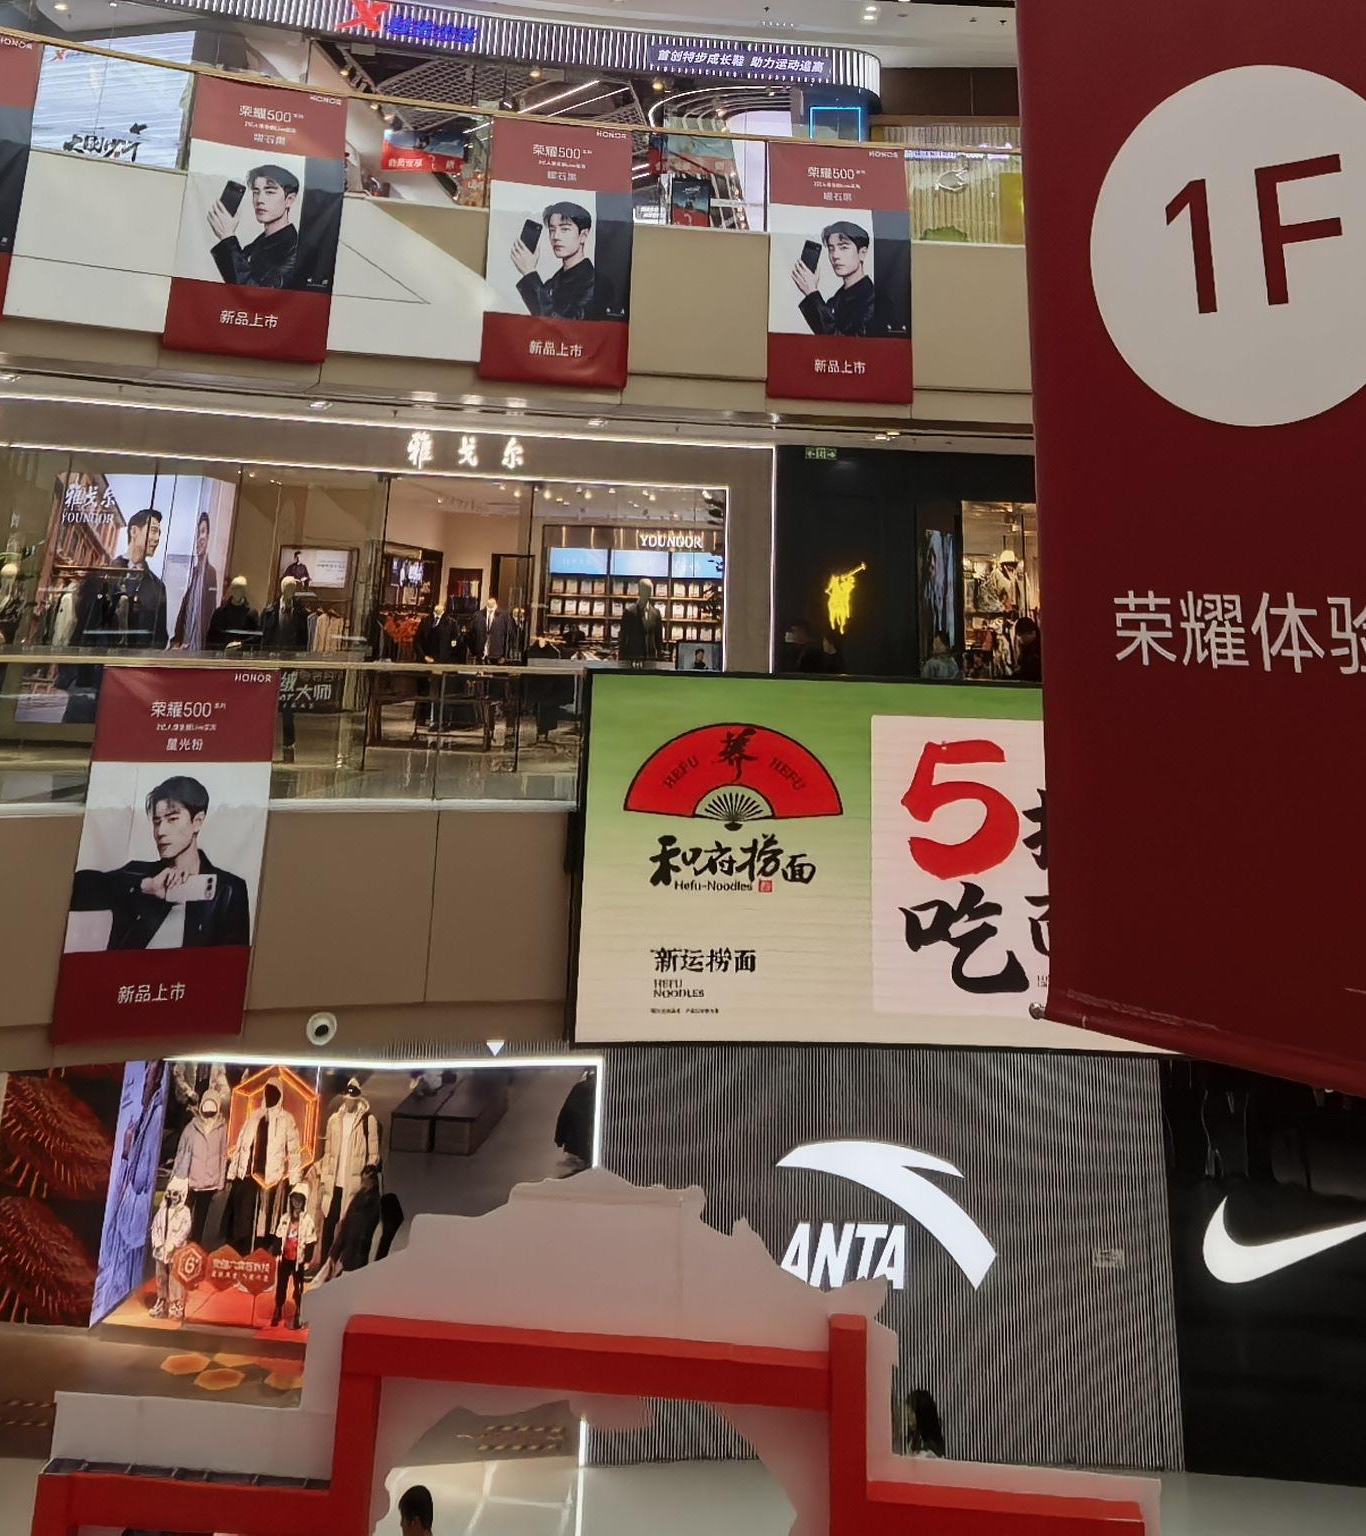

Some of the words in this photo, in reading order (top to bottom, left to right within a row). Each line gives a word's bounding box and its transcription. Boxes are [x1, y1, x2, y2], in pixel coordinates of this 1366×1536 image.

[532, 144, 581, 159] 荣耀500
[807, 166, 855, 180] 荣耀500
[1164, 153, 1343, 315] 1F
[220, 309, 279, 329] 新品上市
[528, 340, 583, 359] 新品上市
[815, 358, 866, 375] 新品上市
[407, 431, 525, 467] 雅戈尔
[65, 482, 116, 512] 雅戈尔
[638, 532, 705, 551] YOUNGOR
[234, 672, 272, 683] HONOR
[150, 701, 212, 718] 荣耀500
[166, 738, 203, 751] 星光粉
[662, 755, 699, 791] HEFU
[768, 757, 806, 791] HEFU
[649, 831, 817, 888] 和府捞面
[673, 879, 753, 893] Hefu-Noodles
[653, 948, 757, 973] 新运捞面
[653, 978, 683, 988] HEFU
[117, 982, 186, 1005] 新品上市
[653, 988, 705, 998] NOODLES
[779, 1222, 906, 1291] ANTA
